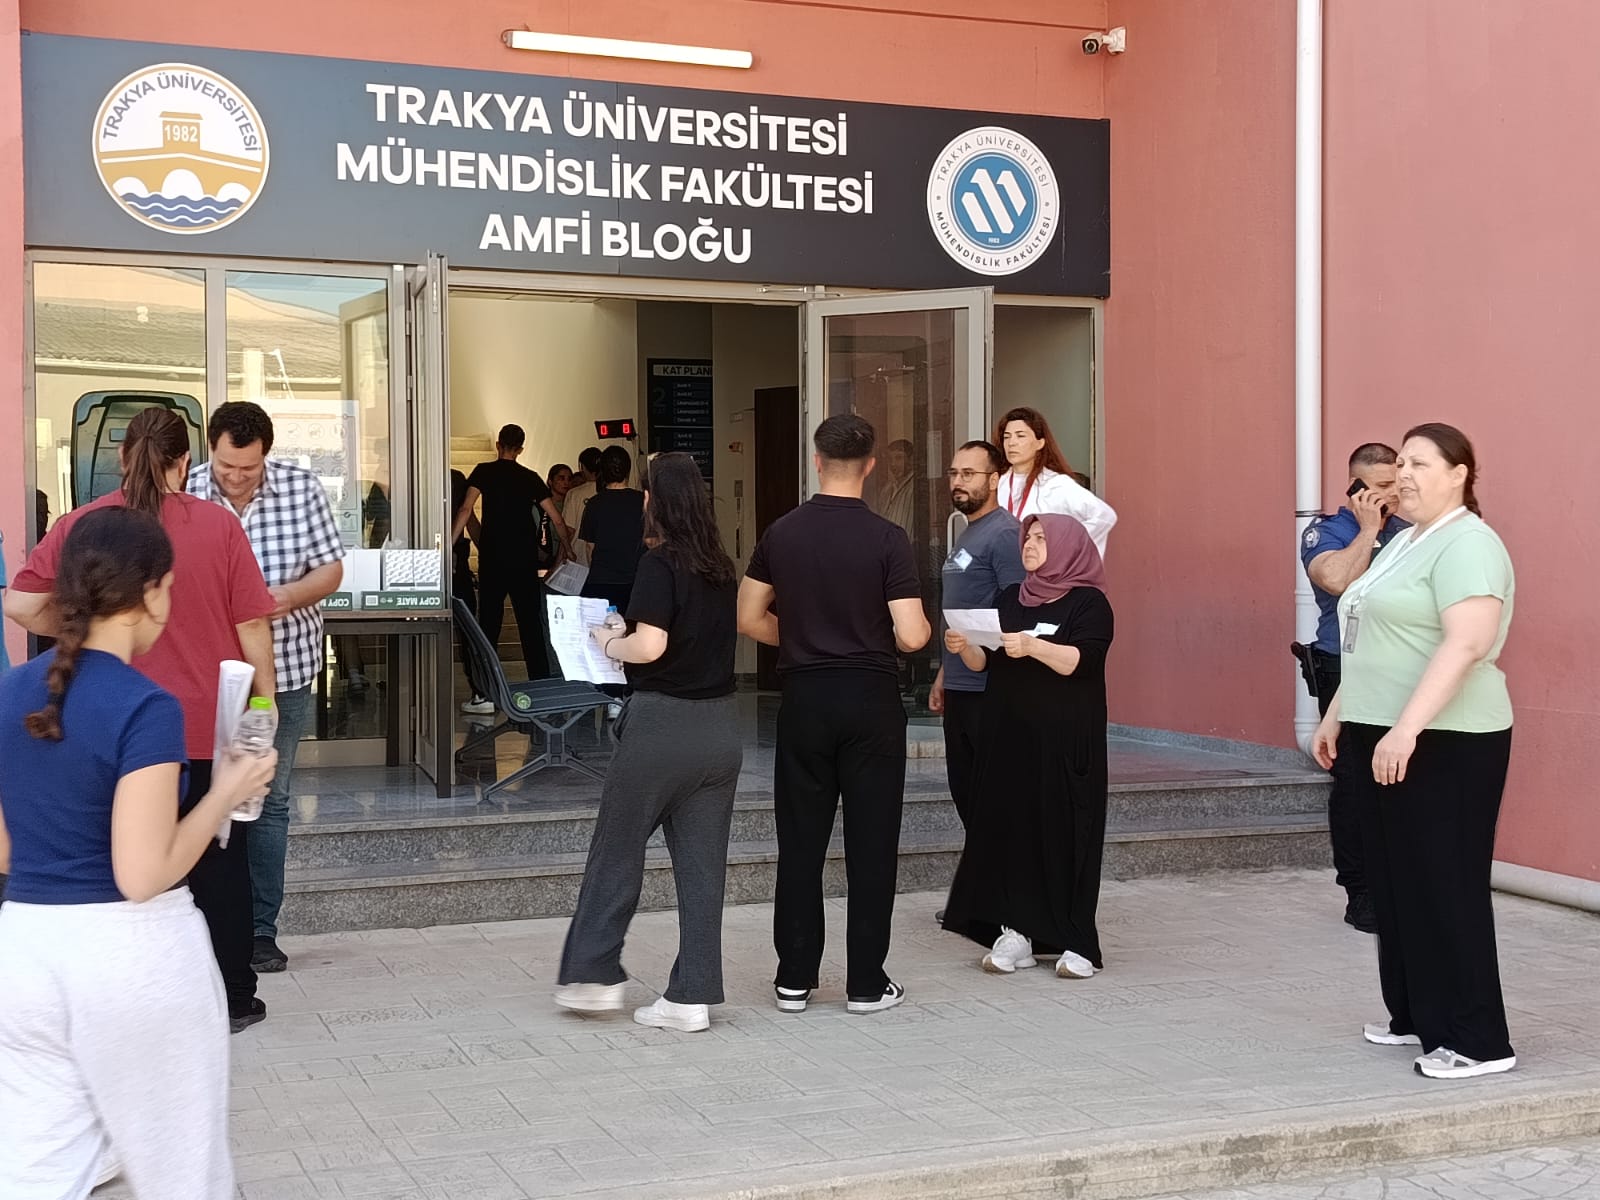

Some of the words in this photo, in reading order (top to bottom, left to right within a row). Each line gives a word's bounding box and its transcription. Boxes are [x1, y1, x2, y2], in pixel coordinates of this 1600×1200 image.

[103, 80, 156, 139] TRAKYA
[157, 72, 262, 151] ÜNİVERSİTESİ
[164, 125, 198, 142] 1982
[366, 84, 553, 134] TRAKYA
[564, 91, 846, 155] ÜNİVERSİTESİ
[337, 137, 651, 200] MÜHENDİSLİK
[662, 163, 873, 213] FAKÜLTESİ
[937, 142, 972, 182] TRAKYA
[976, 135, 1050, 187] ÜNİVERSİTESİ
[479, 210, 592, 255] AMFİ
[603, 218, 752, 263] BLOĞU
[936, 211, 1000, 267] MÜHENDİSLİK
[1006, 216, 1052, 266] FAKÜLTESİ
[663, 366, 682, 376] KAT
[329, 598, 349, 607] COPY
[396, 597, 418, 606] MATE
[419, 597, 441, 606] COPY
